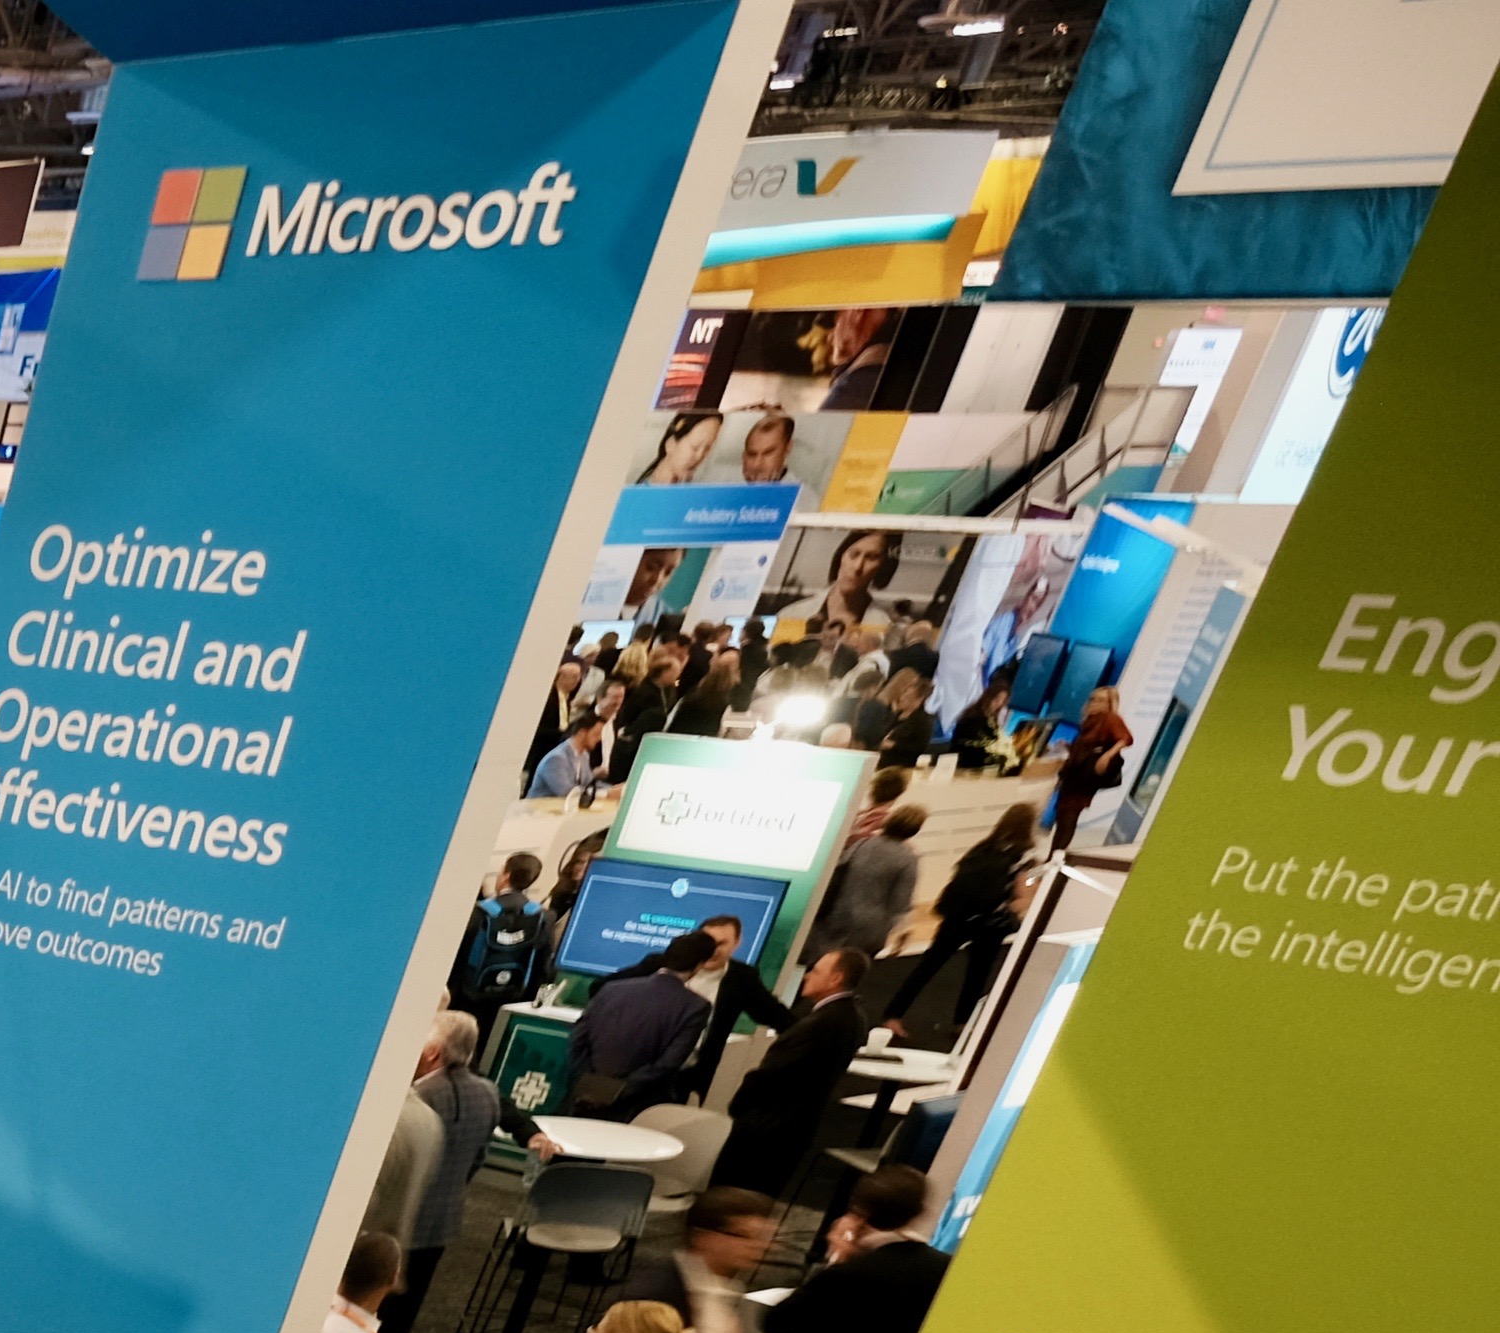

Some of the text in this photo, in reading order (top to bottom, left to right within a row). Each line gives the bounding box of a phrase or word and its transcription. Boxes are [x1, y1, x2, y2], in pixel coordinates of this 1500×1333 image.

[245, 161, 576, 258] Microsoft
[684, 506, 779, 525] Ambulatory Solutions
[29, 524, 266, 600] Optimize
[7, 610, 308, 692] Clinical and
[693, 802, 796, 831] Fortified
[1211, 846, 1389, 907] Put the
